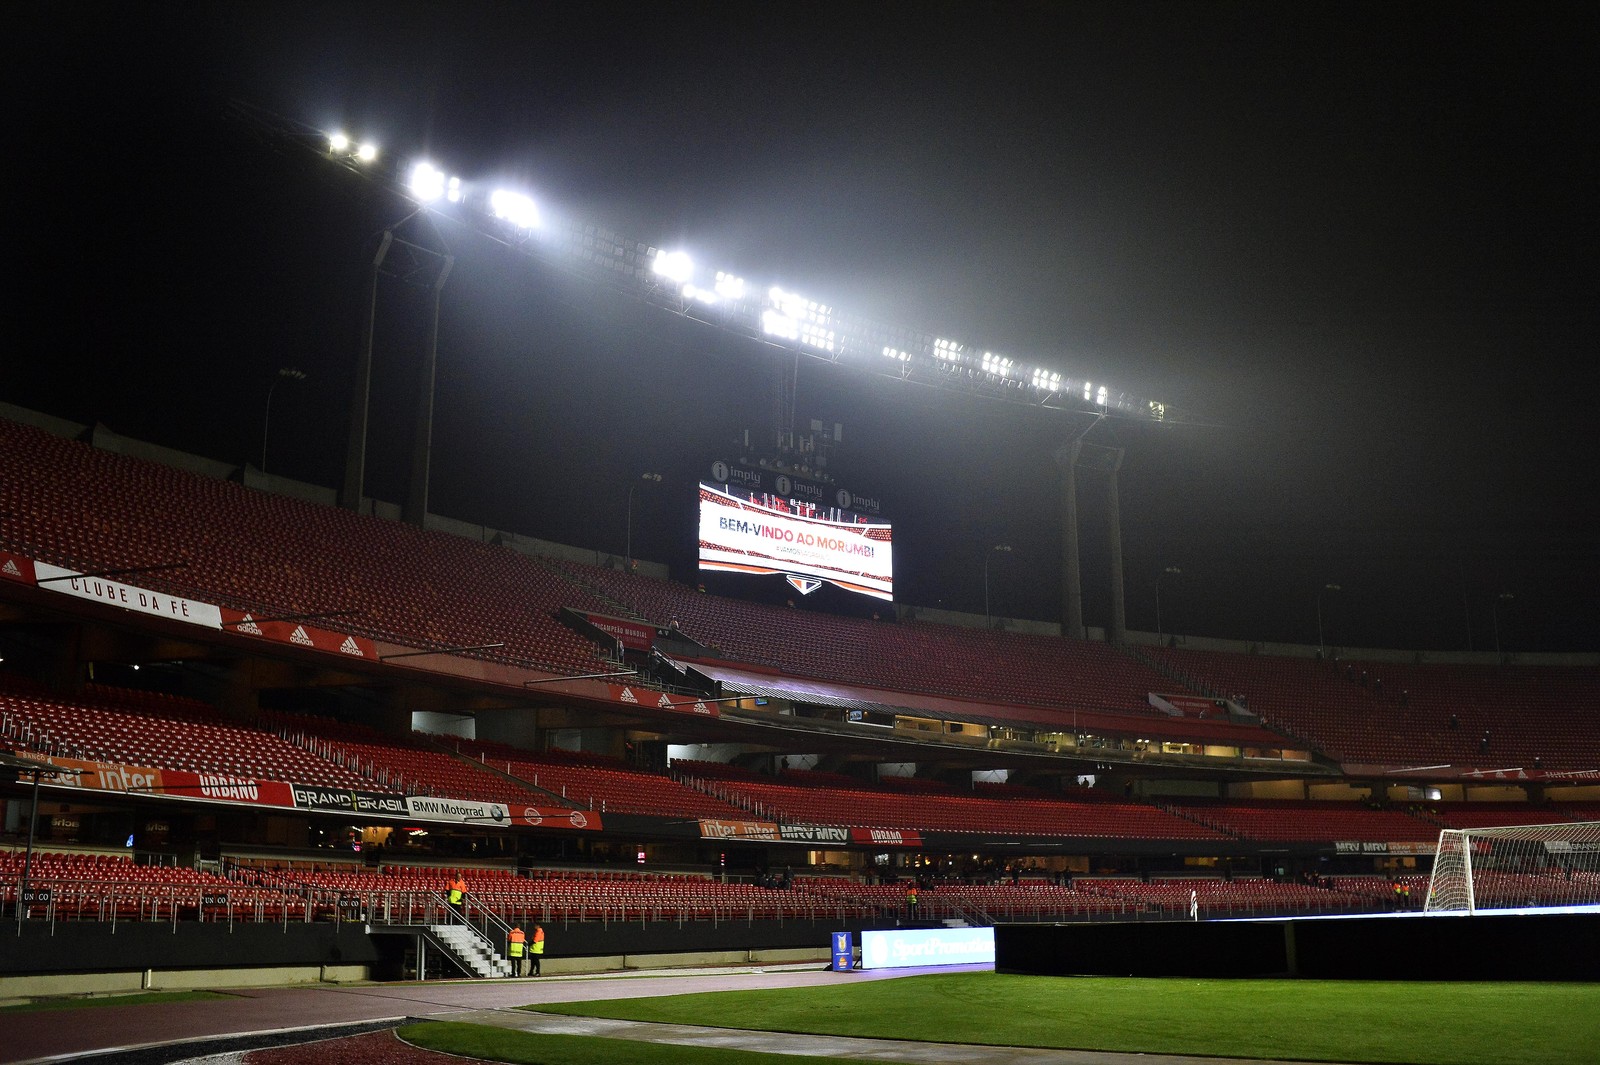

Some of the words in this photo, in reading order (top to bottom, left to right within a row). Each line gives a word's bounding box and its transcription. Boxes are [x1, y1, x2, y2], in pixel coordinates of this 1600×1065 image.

[730, 466, 761, 483] imply
[794, 481, 823, 497] imply
[852, 494, 880, 510] imply
[719, 517, 794, 542] BEM-VINDO
[797, 534, 814, 546] AO
[817, 536, 875, 558] MORUMBI
[71, 577, 128, 603] CLUBE
[140, 593, 160, 610] DA
[170, 600, 190, 617] FÉ
[237, 624, 263, 636] adidas
[624, 628, 648, 639] MUNDIAL
[289, 636, 314, 646] adidas
[340, 646, 364, 657] adidas
[98, 766, 156, 792] inter
[199, 774, 259, 801] URBANO
[295, 790, 352, 807] GRAND
[357, 796, 409, 811] BRASIL
[412, 800, 439, 813] BMW
[441, 802, 485, 818] Motorrad
[704, 821, 737, 838] inter
[744, 823, 775, 840] inter
[781, 825, 814, 839] MRV
[815, 827, 848, 841] MRV
[871, 829, 903, 845] URBANO
[1336, 842, 1360, 851] MRV
[1363, 842, 1387, 851] MRV
